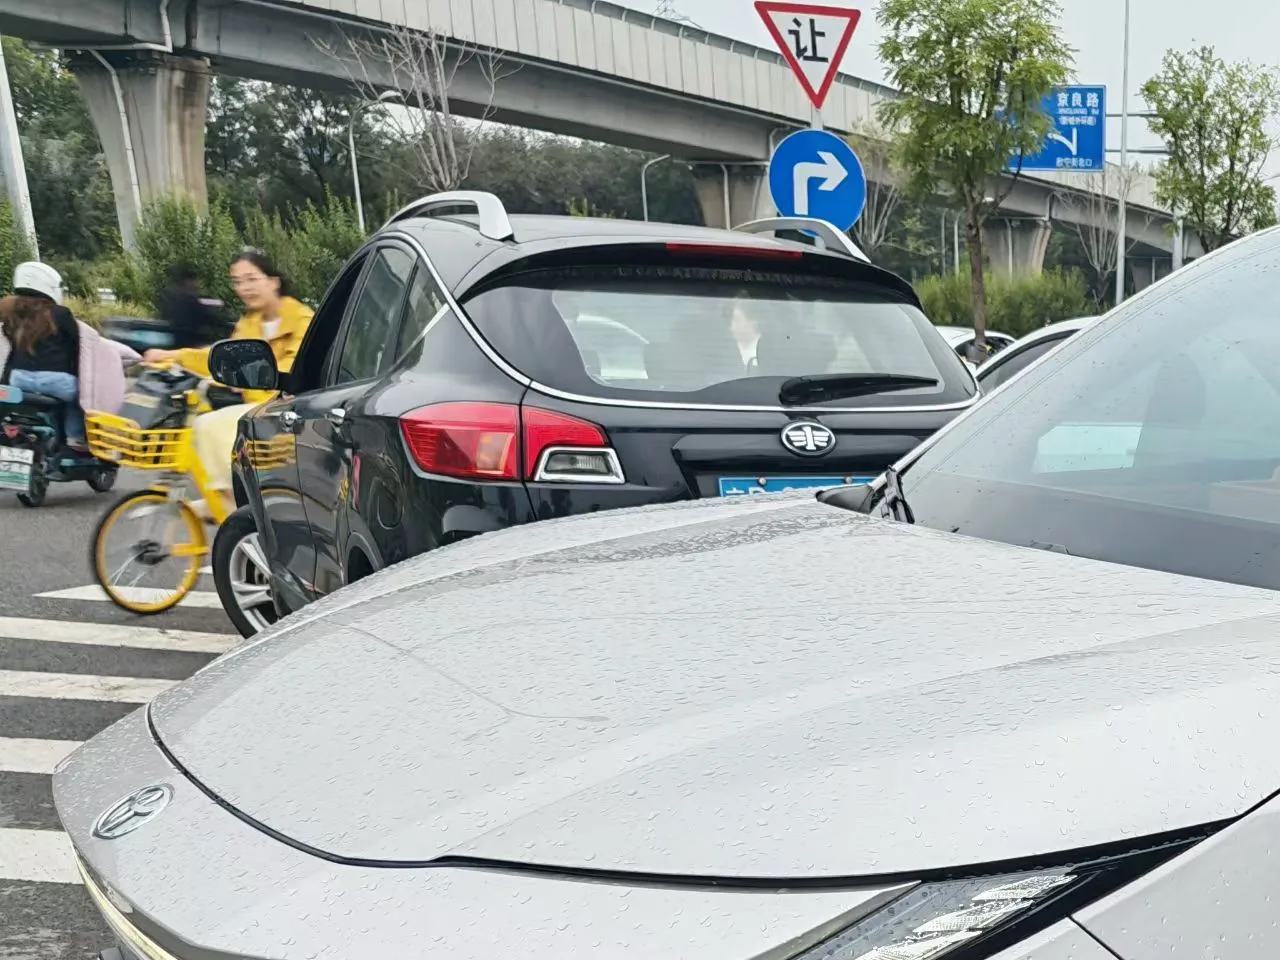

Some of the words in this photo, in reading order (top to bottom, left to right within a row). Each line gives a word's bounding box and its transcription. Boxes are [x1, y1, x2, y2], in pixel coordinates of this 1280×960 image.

[787, 17, 829, 63] 让
[1057, 91, 1099, 107] 京良路
